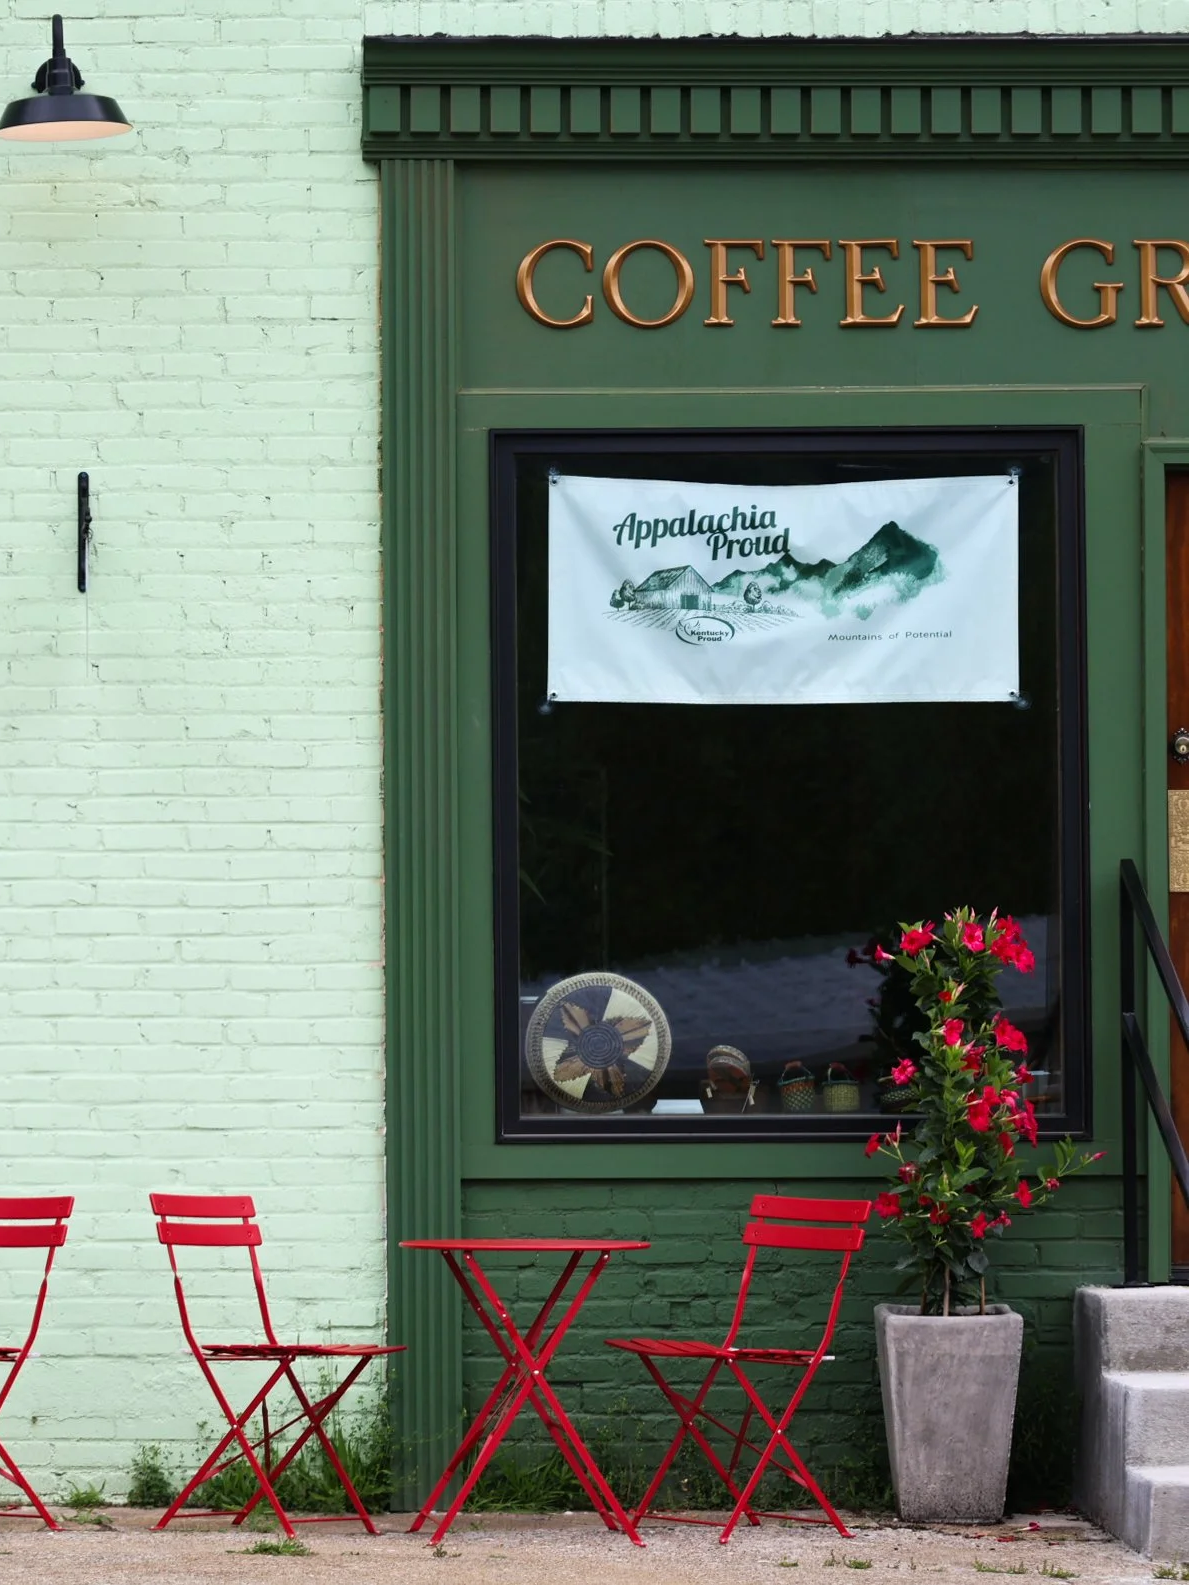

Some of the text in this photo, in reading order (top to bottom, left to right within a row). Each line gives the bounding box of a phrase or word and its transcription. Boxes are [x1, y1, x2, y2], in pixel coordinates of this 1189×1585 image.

[515, 238, 979, 330] COFFEE
[612, 504, 778, 549] Appalachia
[706, 527, 791, 561] Proud
[691, 630, 730, 638] Kentucky
[827, 630, 953, 641] Mountains of Potential
